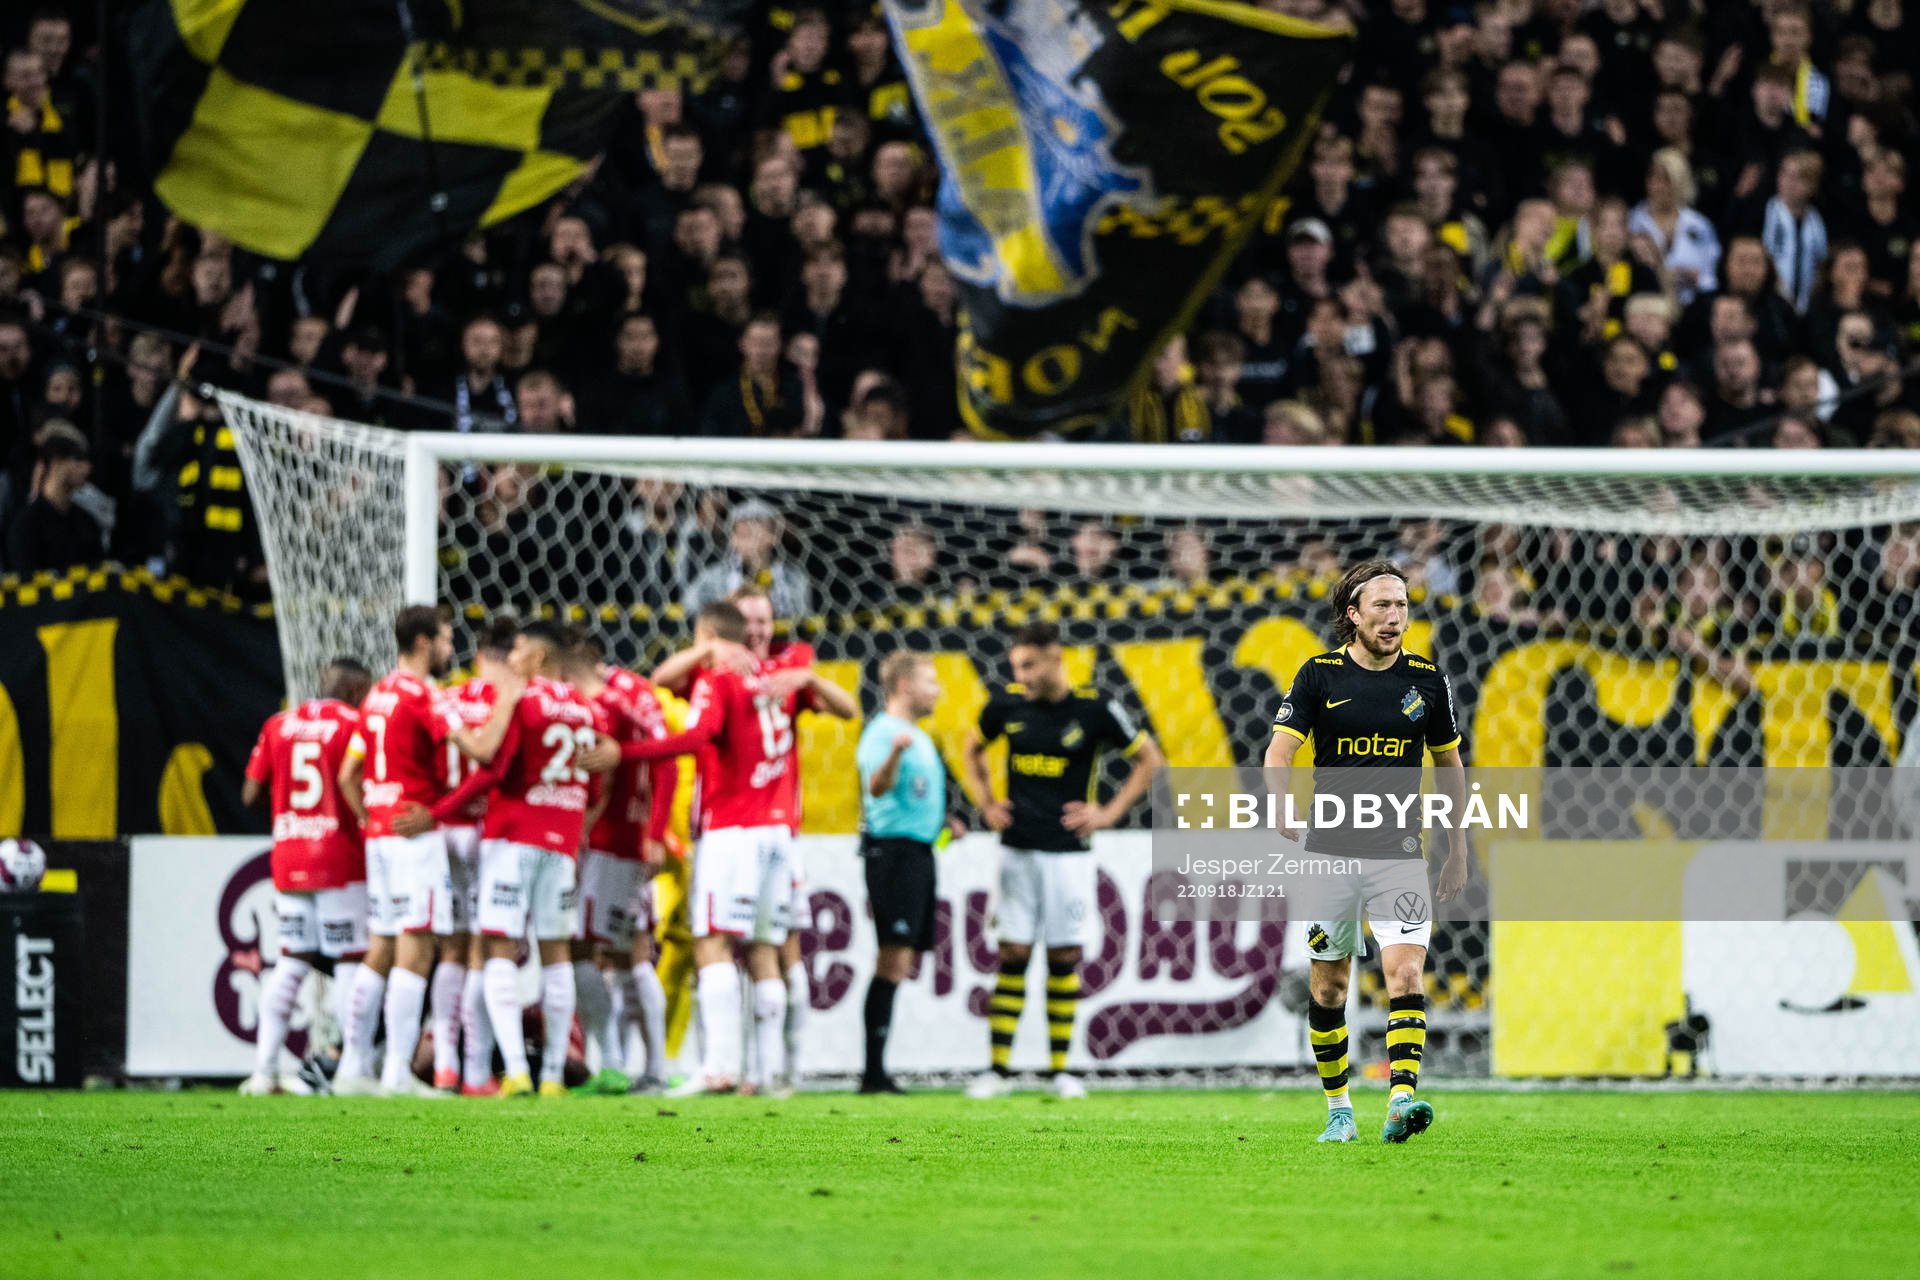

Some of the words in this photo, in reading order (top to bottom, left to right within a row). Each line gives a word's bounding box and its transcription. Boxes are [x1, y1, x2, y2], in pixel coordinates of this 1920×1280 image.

[290, 742, 323, 810] 5
[1337, 733, 1412, 757] notar
[16, 934, 55, 1084] SELECT
